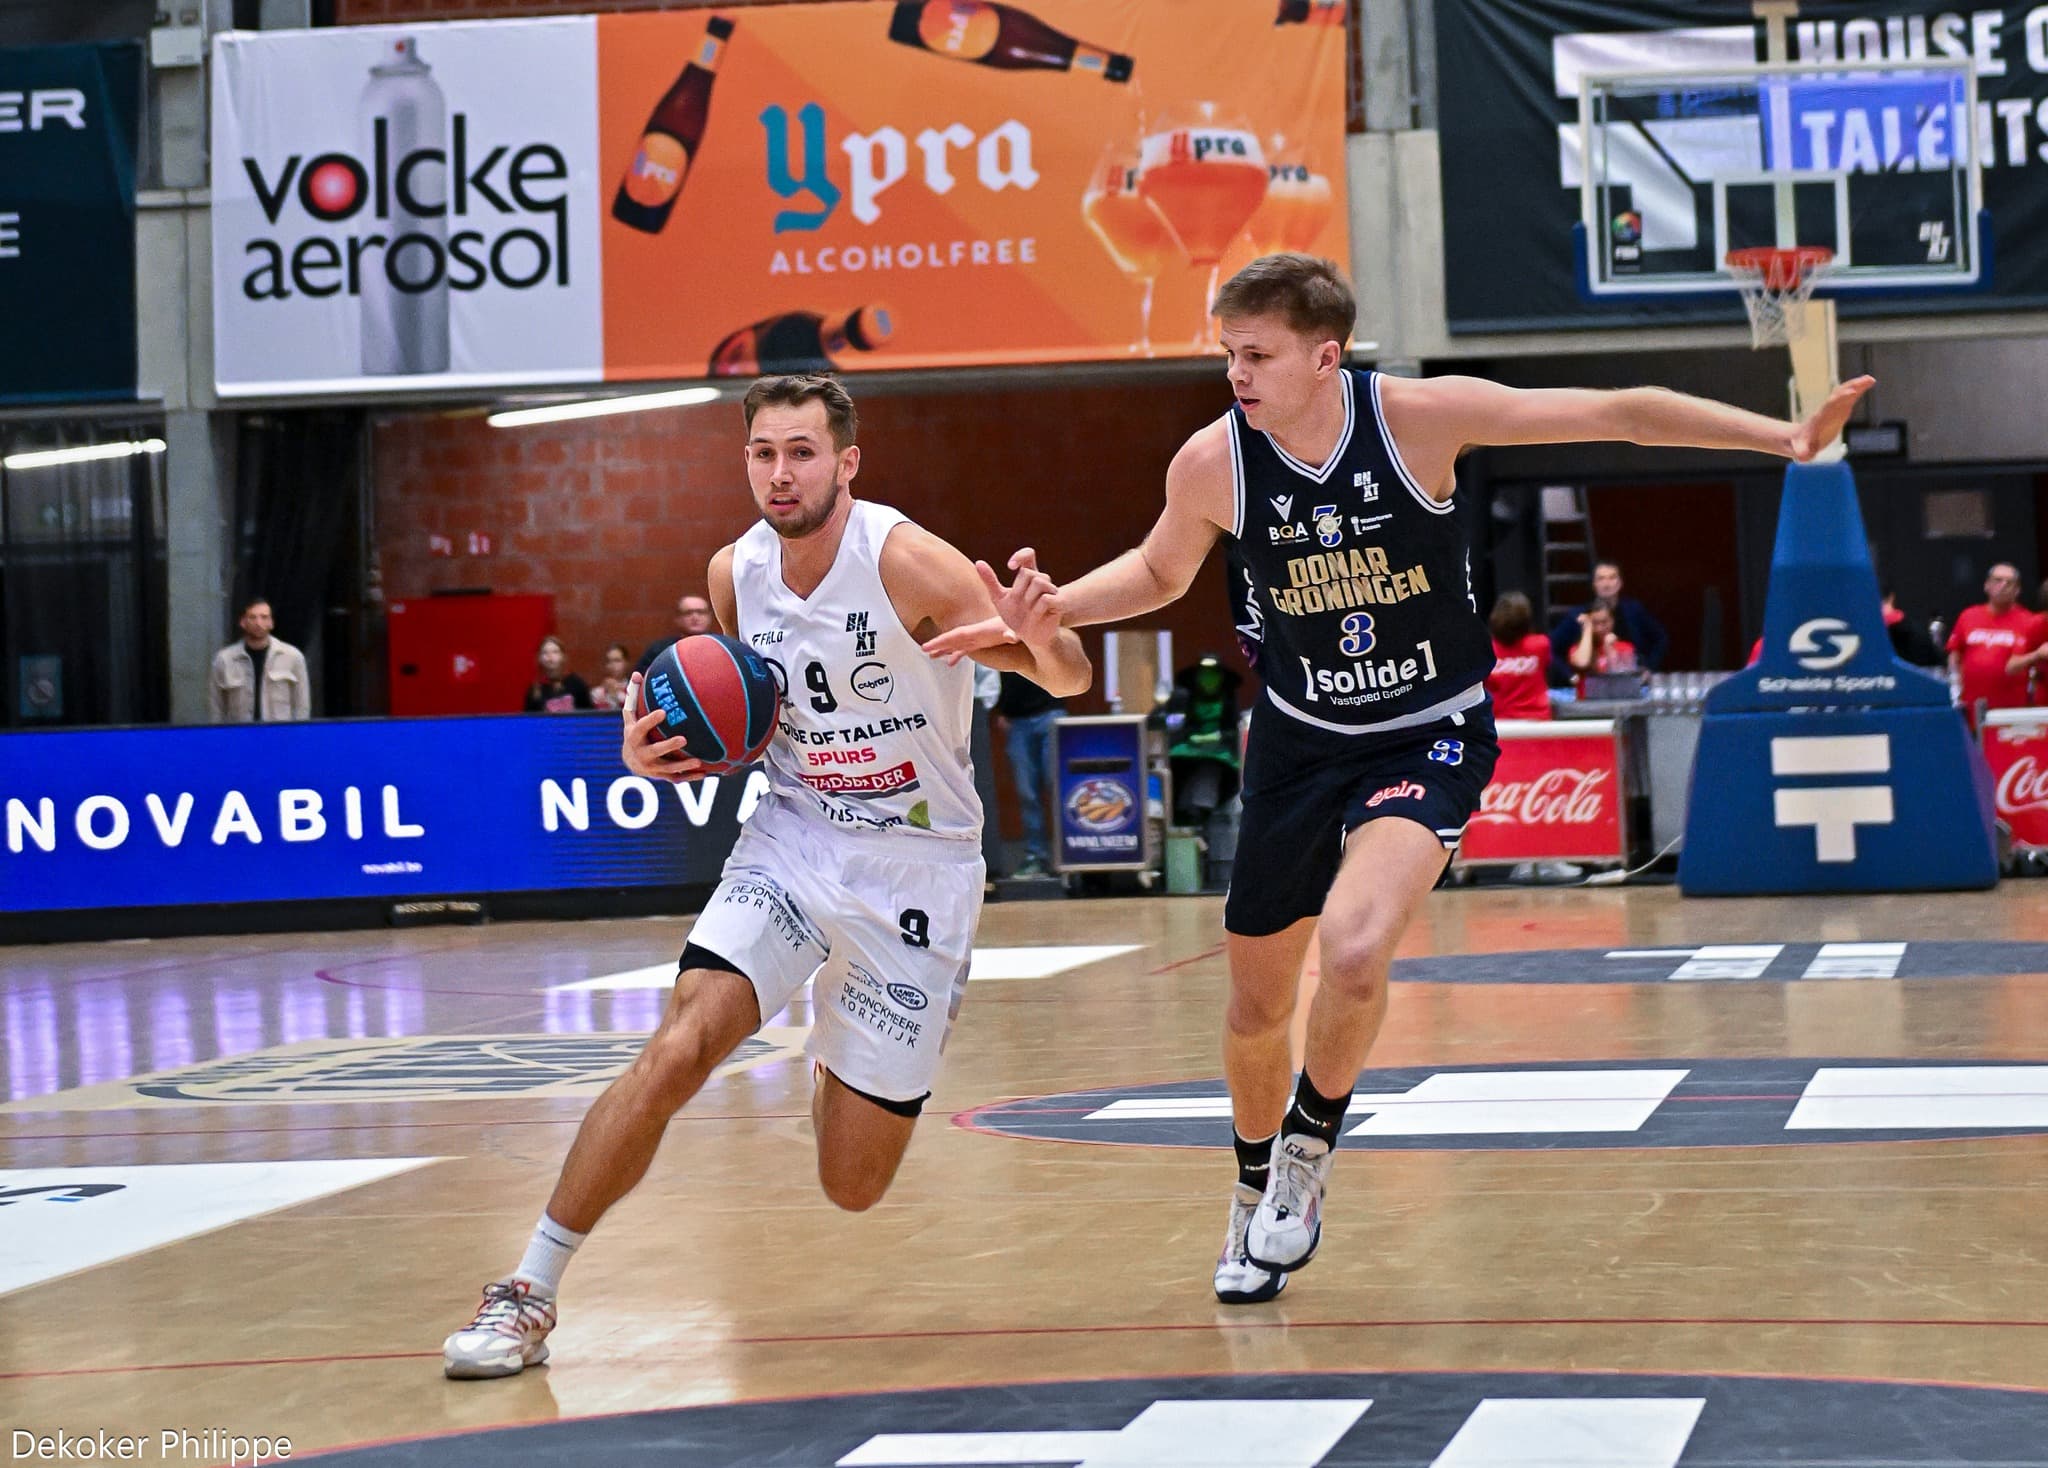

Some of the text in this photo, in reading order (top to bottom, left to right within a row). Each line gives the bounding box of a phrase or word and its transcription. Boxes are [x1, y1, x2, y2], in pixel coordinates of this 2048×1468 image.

[242, 113, 568, 226] volcke
[243, 200, 570, 300] aerosol
[770, 238, 1037, 275] ALCOHOLFREE
[1268, 521, 1309, 541] BQA
[1287, 546, 1392, 588] DONAR
[1269, 565, 1431, 616] GRONINGEN
[846, 611, 869, 632] BN
[855, 631, 878, 651] XT
[1339, 611, 1377, 657] 3
[805, 661, 838, 714] 9
[1330, 691, 1381, 706] Vastgoed
[810, 730, 835, 746] OF
[839, 713, 927, 744] TALENTS
[807, 746, 877, 766] SPURS
[1428, 739, 1464, 766] 3
[1479, 768, 1611, 824] ca-Cola
[7, 785, 424, 853] NOVABIL
[724, 894, 802, 952] KORTRIJK
[900, 908, 930, 949] 9
[840, 994, 917, 1049] KORTRIJK
[843, 981, 922, 1036] DEJONCKHEERE
